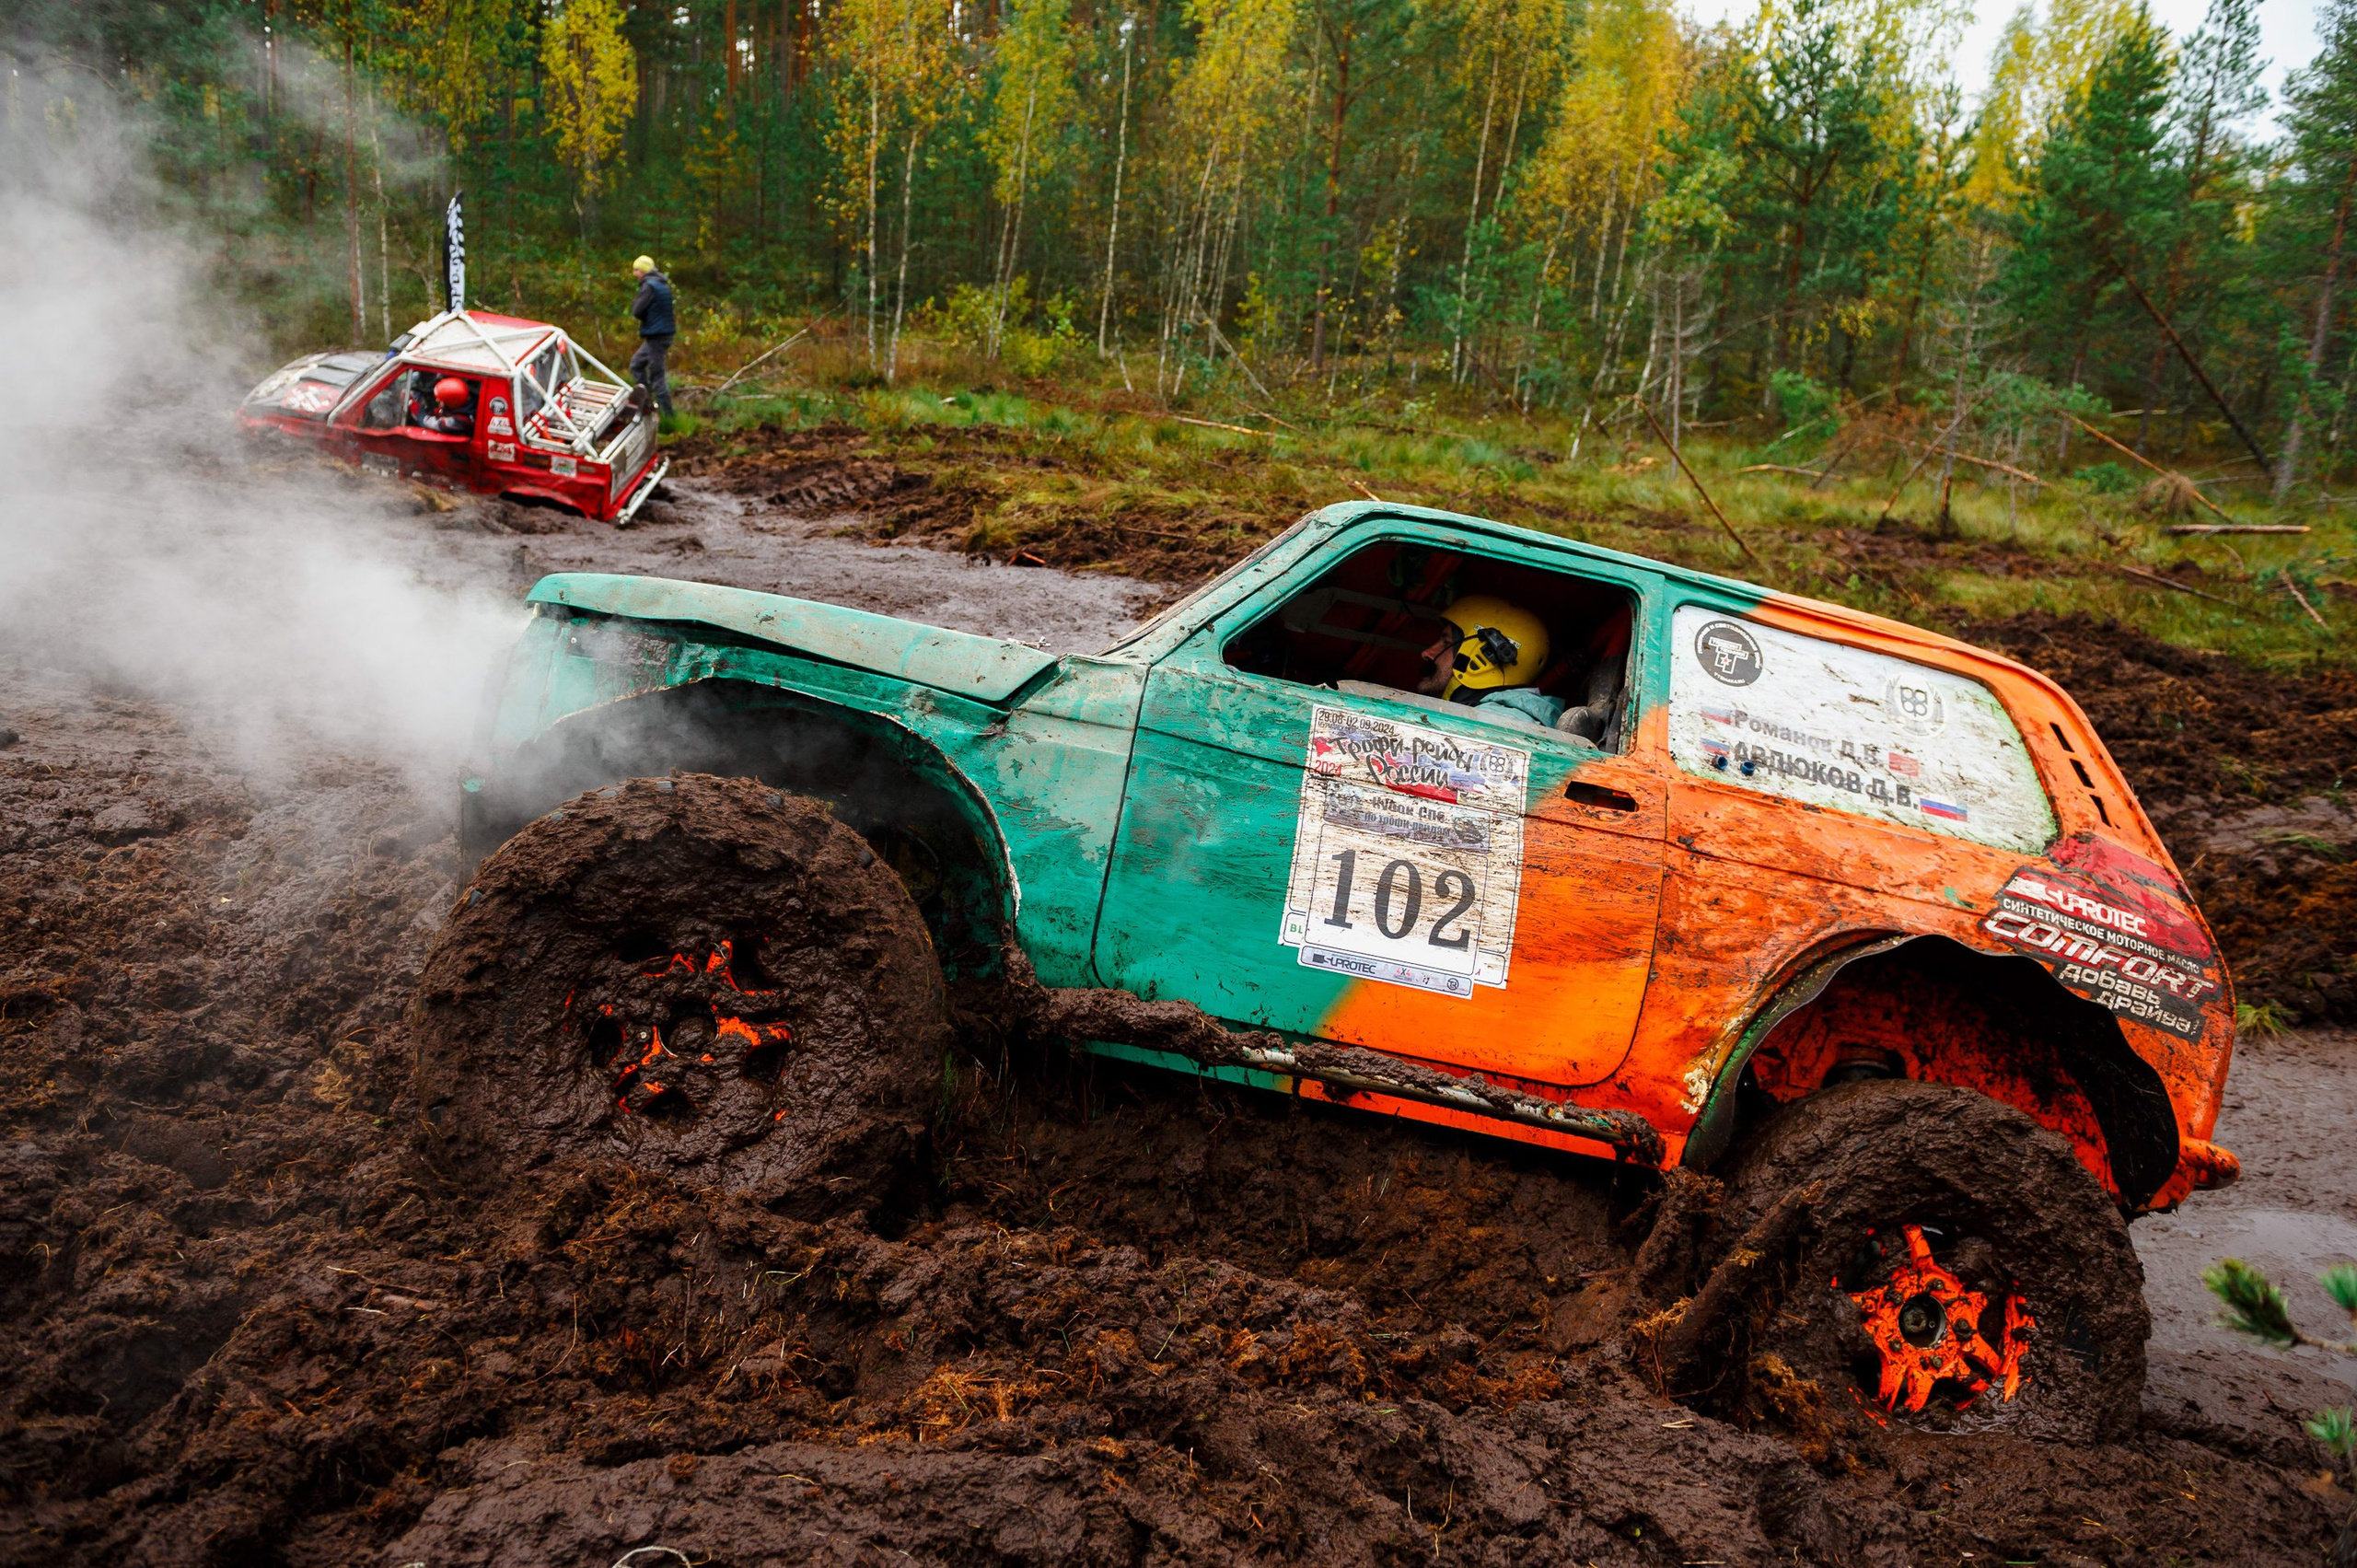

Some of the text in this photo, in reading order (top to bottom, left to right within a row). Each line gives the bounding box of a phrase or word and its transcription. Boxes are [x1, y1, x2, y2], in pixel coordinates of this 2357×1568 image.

[1734, 709, 1832, 752] Романов
[1314, 760, 1342, 777] 2024
[1365, 753, 1449, 787] России
[1324, 849, 1475, 952] 102
[2043, 884, 2148, 937] SUPROTEC
[1984, 912, 2214, 998] COMFORT
[2003, 898, 2200, 974] СИНТЕТИЧЕСКОЕ МОТОРНОЕ МАСЛО
[1323, 956, 1376, 974] SUPROTEC
